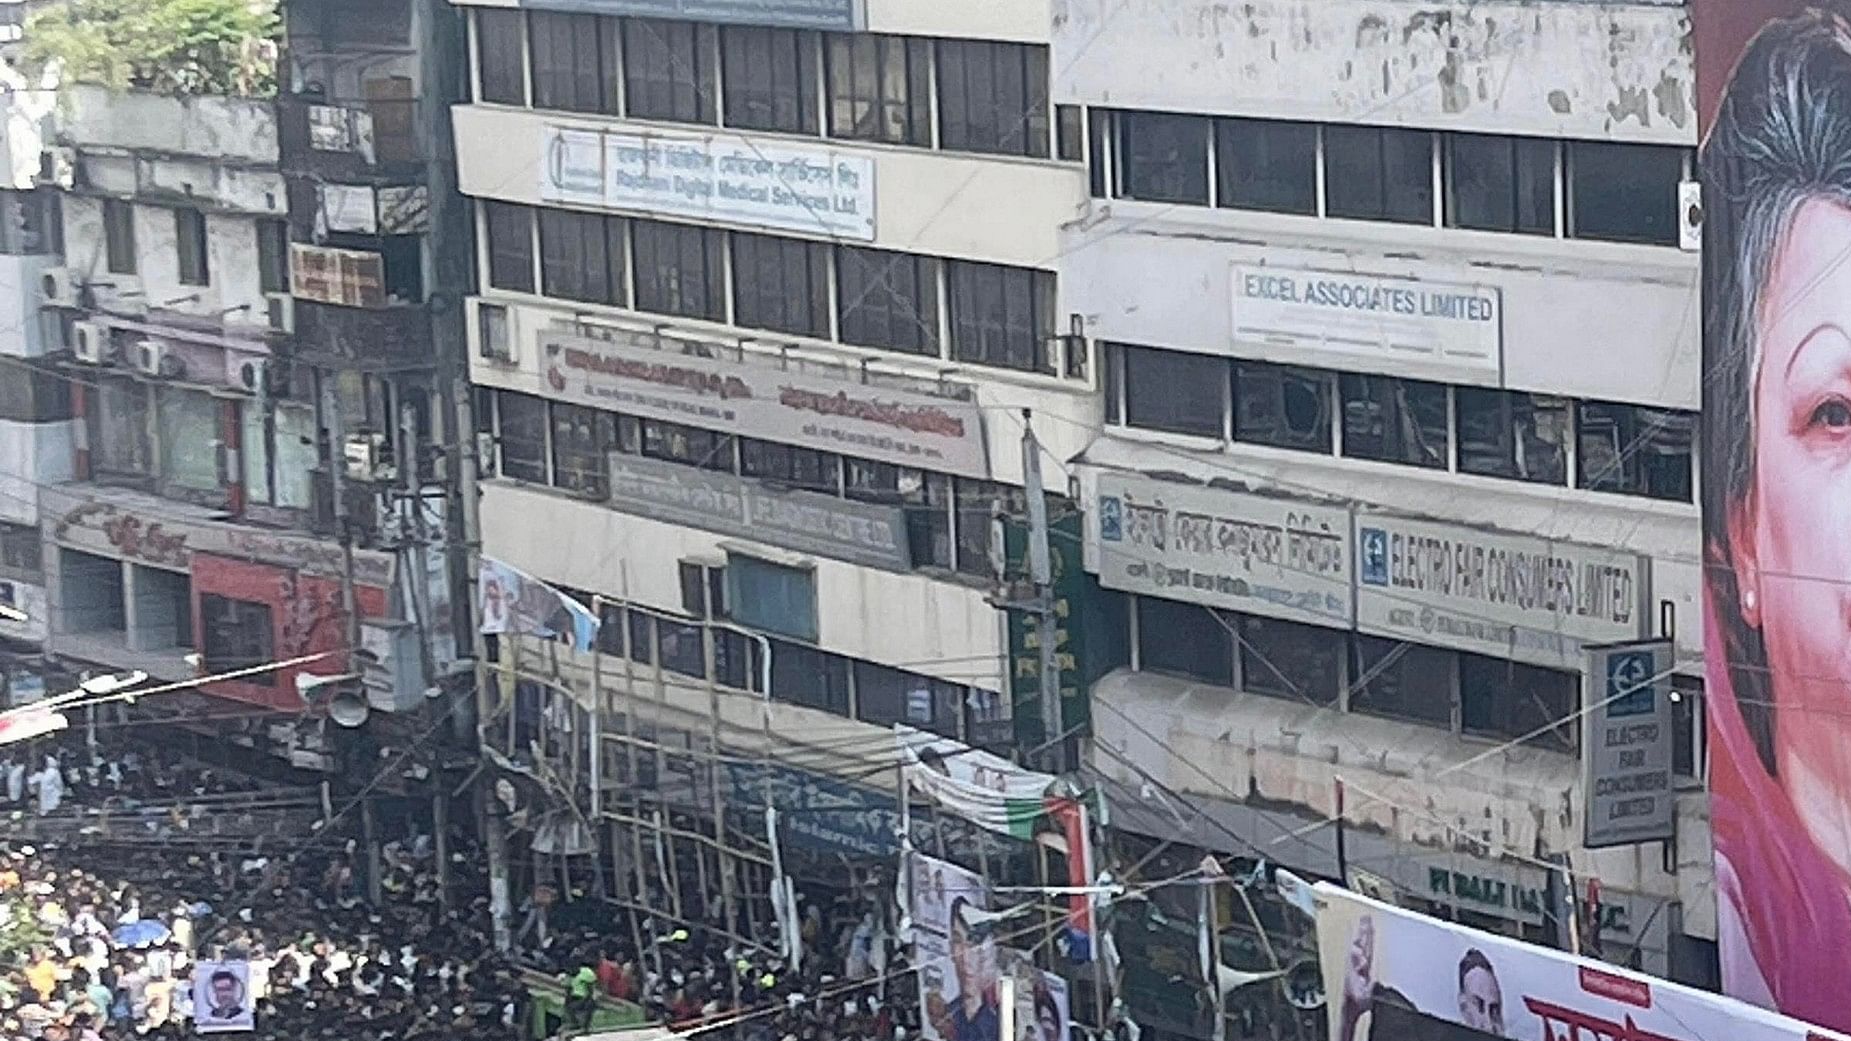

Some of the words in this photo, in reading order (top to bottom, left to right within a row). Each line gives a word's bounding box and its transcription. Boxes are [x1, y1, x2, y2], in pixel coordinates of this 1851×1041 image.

[1245, 275, 1297, 303] EXCEL
[1305, 280, 1415, 314] ASSOCIATES
[1421, 292, 1493, 322] LIMITED
[1392, 533, 1450, 595] ELECTRO
[1457, 543, 1485, 599] FAIR
[1489, 547, 1572, 614] CONSUMERS
[1577, 559, 1632, 624] LIMITED
[1596, 770, 1668, 796] CONSUMERS
